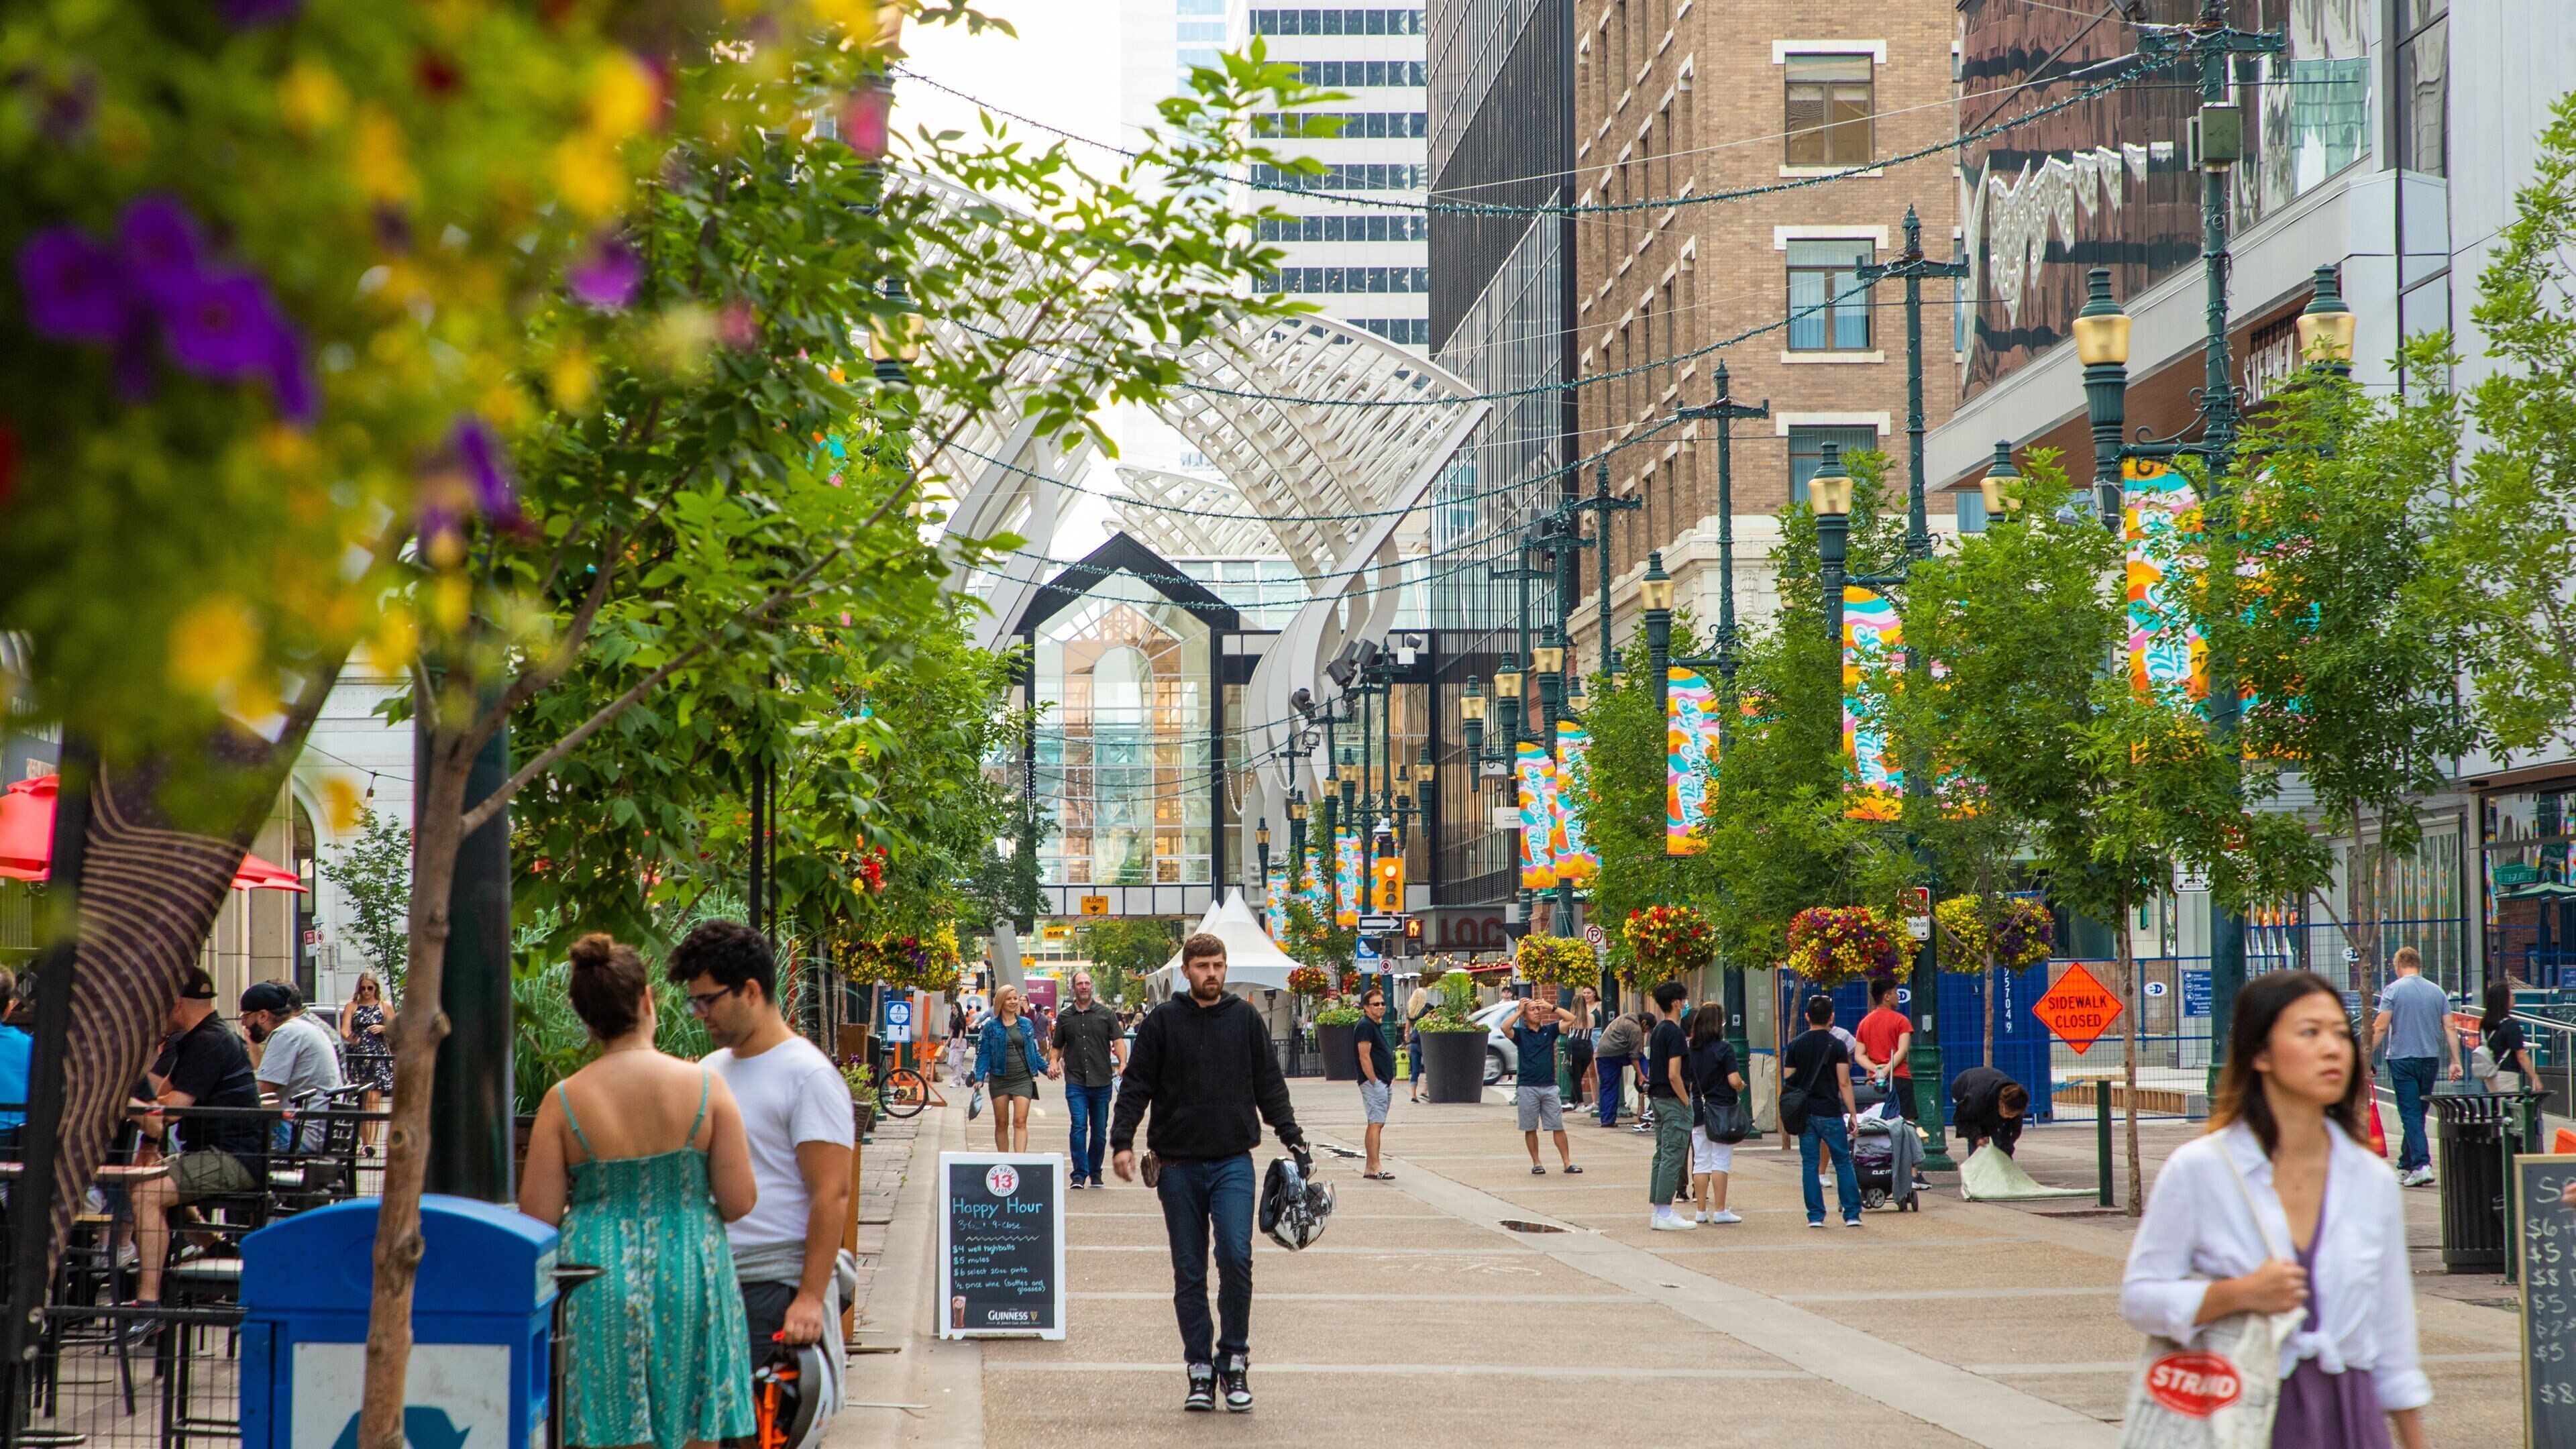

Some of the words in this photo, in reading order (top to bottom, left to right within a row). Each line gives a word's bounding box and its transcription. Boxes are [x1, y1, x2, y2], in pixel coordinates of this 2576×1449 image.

[2048, 996, 2107, 1010] SIDEWALK
[2055, 1014, 2102, 1028] CLOSED
[991, 1174, 1012, 1188] 13
[953, 1197, 999, 1219] Happy
[1006, 1197, 1043, 1214] Hour
[983, 1244, 1016, 1254] highballs
[1010, 1266, 1028, 1275] pints
[965, 1281, 983, 1289] price
[1017, 1286, 1046, 1295] glasses)
[987, 1309, 1028, 1321] GUINNESS
